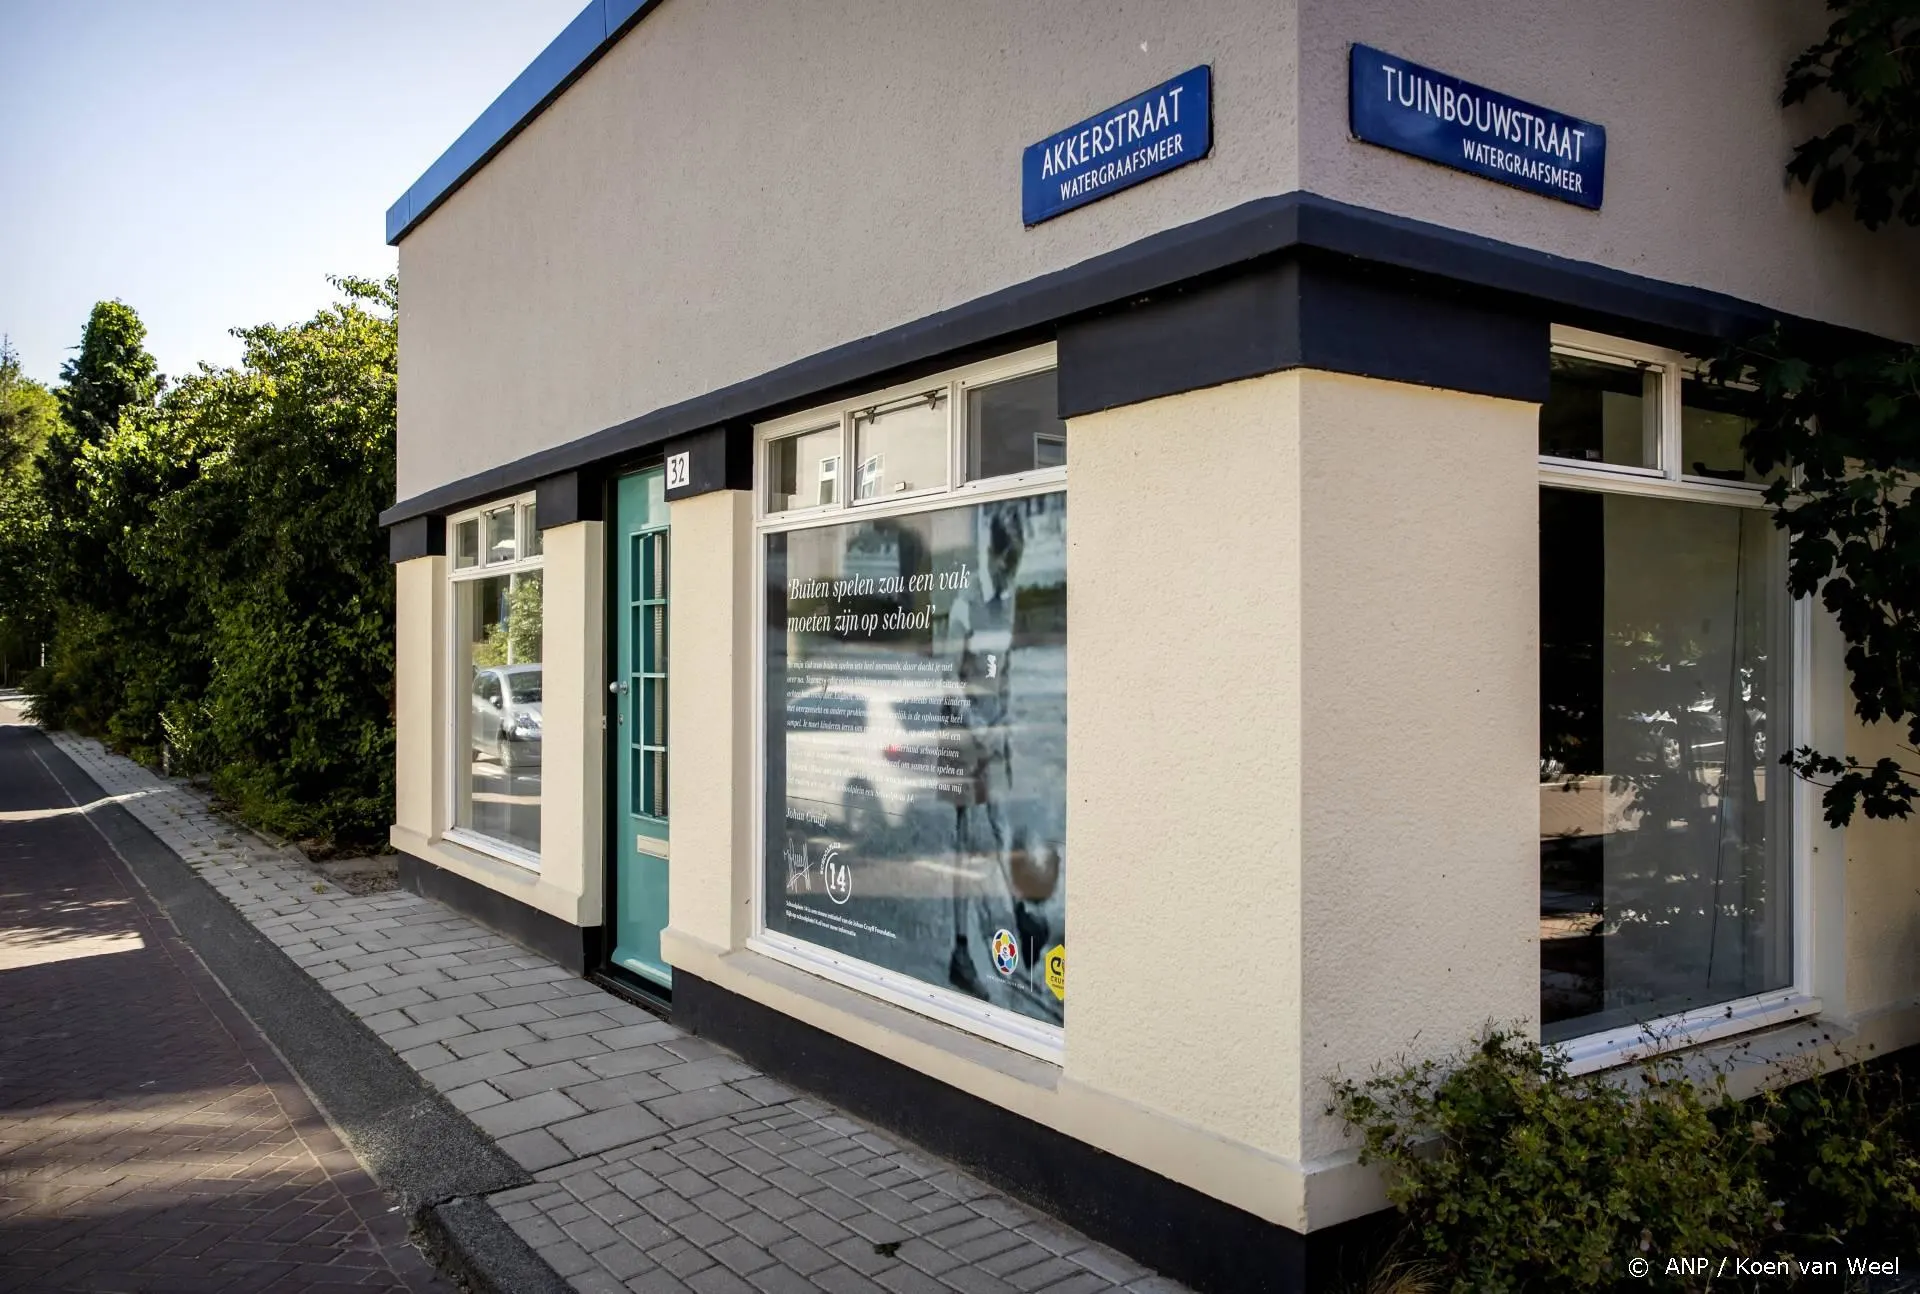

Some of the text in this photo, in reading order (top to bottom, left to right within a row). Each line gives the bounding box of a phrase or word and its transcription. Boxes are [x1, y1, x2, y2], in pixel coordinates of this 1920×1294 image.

[1382, 64, 1585, 163] TUINBOUWSTRAAT
[1041, 86, 1183, 180] AKKERSTRAAT
[1060, 133, 1184, 201] WATERGRAAFSMEER
[1463, 138, 1583, 194] WATERGRAAFSMEER
[671, 456, 685, 485] 32
[833, 573, 874, 603] spelen
[878, 574, 905, 595] zou
[909, 571, 935, 592] een
[939, 564, 970, 590] vak
[787, 613, 831, 633] moeten
[834, 609, 859, 636] zijn
[861, 613, 878, 637] op
[937, 764, 955, 776] spelen
[956, 767, 964, 776] en
[951, 783, 963, 795] mij
[786, 807, 805, 821] Johan
[829, 862, 846, 892] 14
